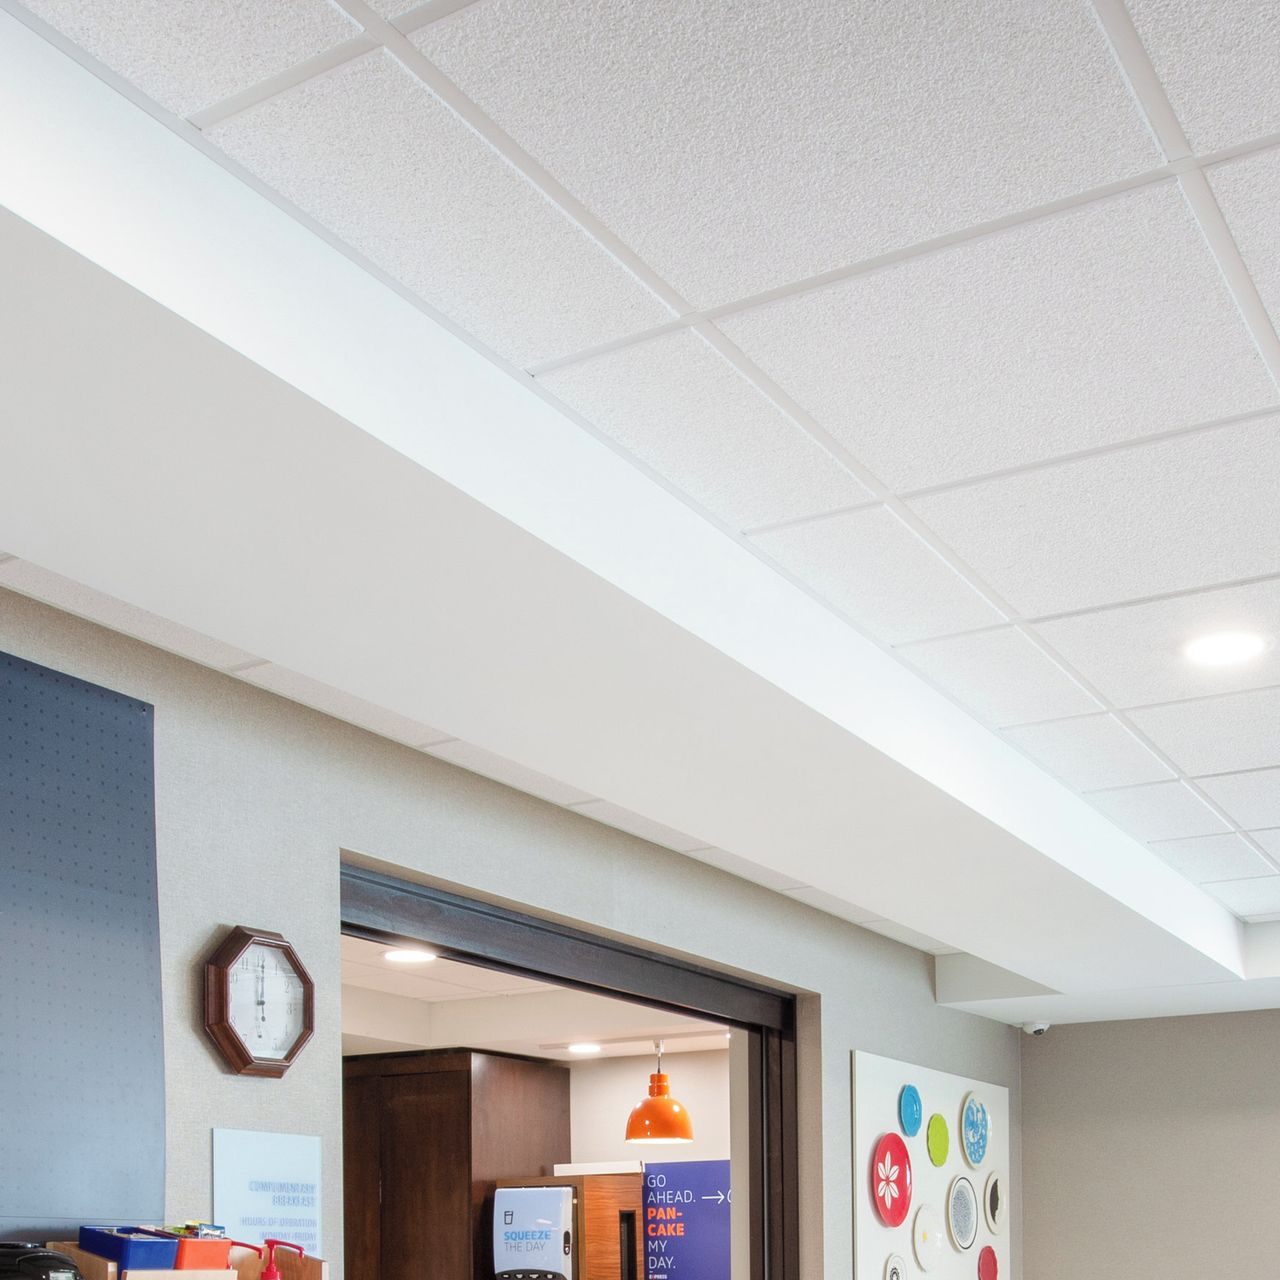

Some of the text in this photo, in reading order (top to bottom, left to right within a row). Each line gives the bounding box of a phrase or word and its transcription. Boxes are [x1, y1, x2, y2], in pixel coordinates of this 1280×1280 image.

[647, 1174, 666, 1188] GO
[647, 1190, 696, 1204] AHEAD.
[647, 1207, 683, 1220] PAN-
[504, 1230, 552, 1241] SQUEEZE
[647, 1223, 685, 1237] CAKE
[504, 1241, 546, 1252] THE DAY
[648, 1240, 668, 1253] MY
[648, 1256, 676, 1269] DAY.
